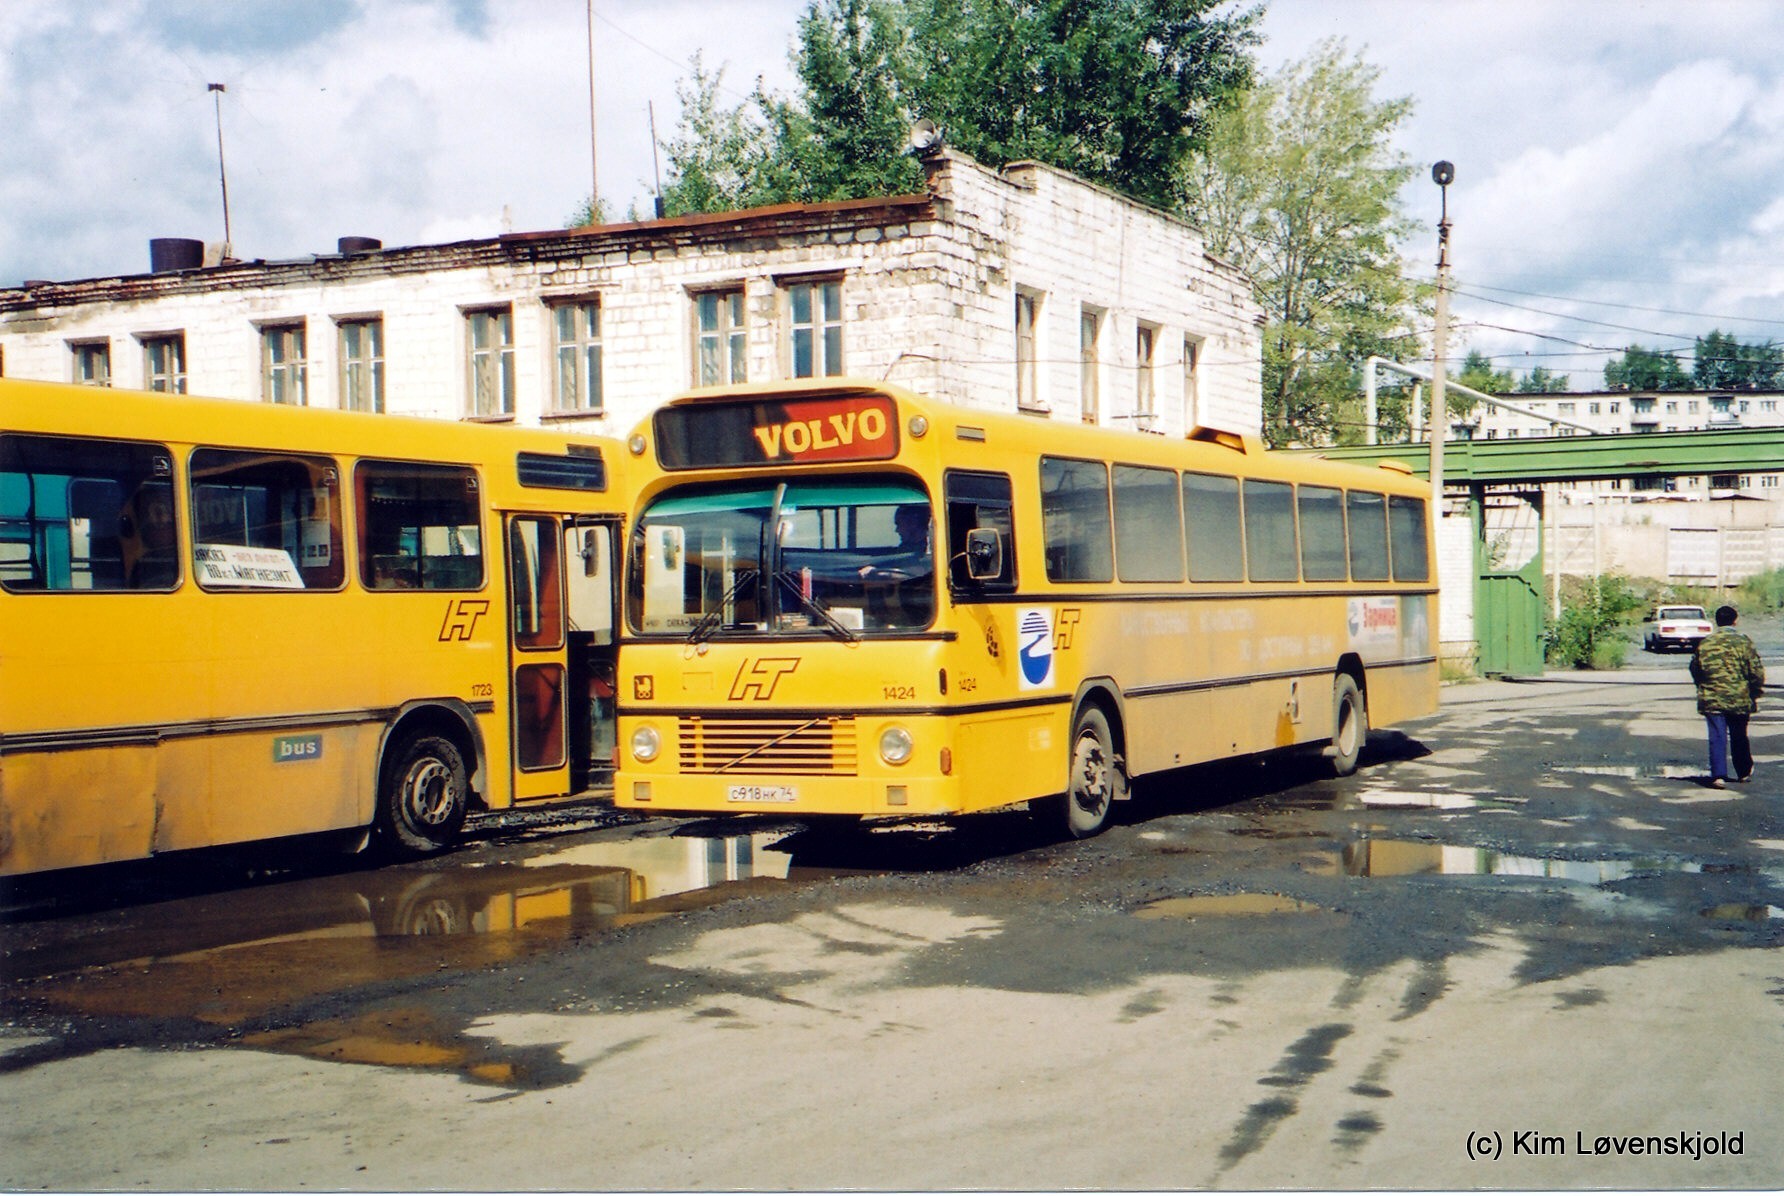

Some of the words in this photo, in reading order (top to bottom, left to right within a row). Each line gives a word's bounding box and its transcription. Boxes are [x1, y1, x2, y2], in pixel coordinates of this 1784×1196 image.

[753, 407, 887, 459] VOLVO
[472, 683, 493, 696] 1723
[883, 686, 915, 699] 1424
[281, 740, 317, 756] bus
